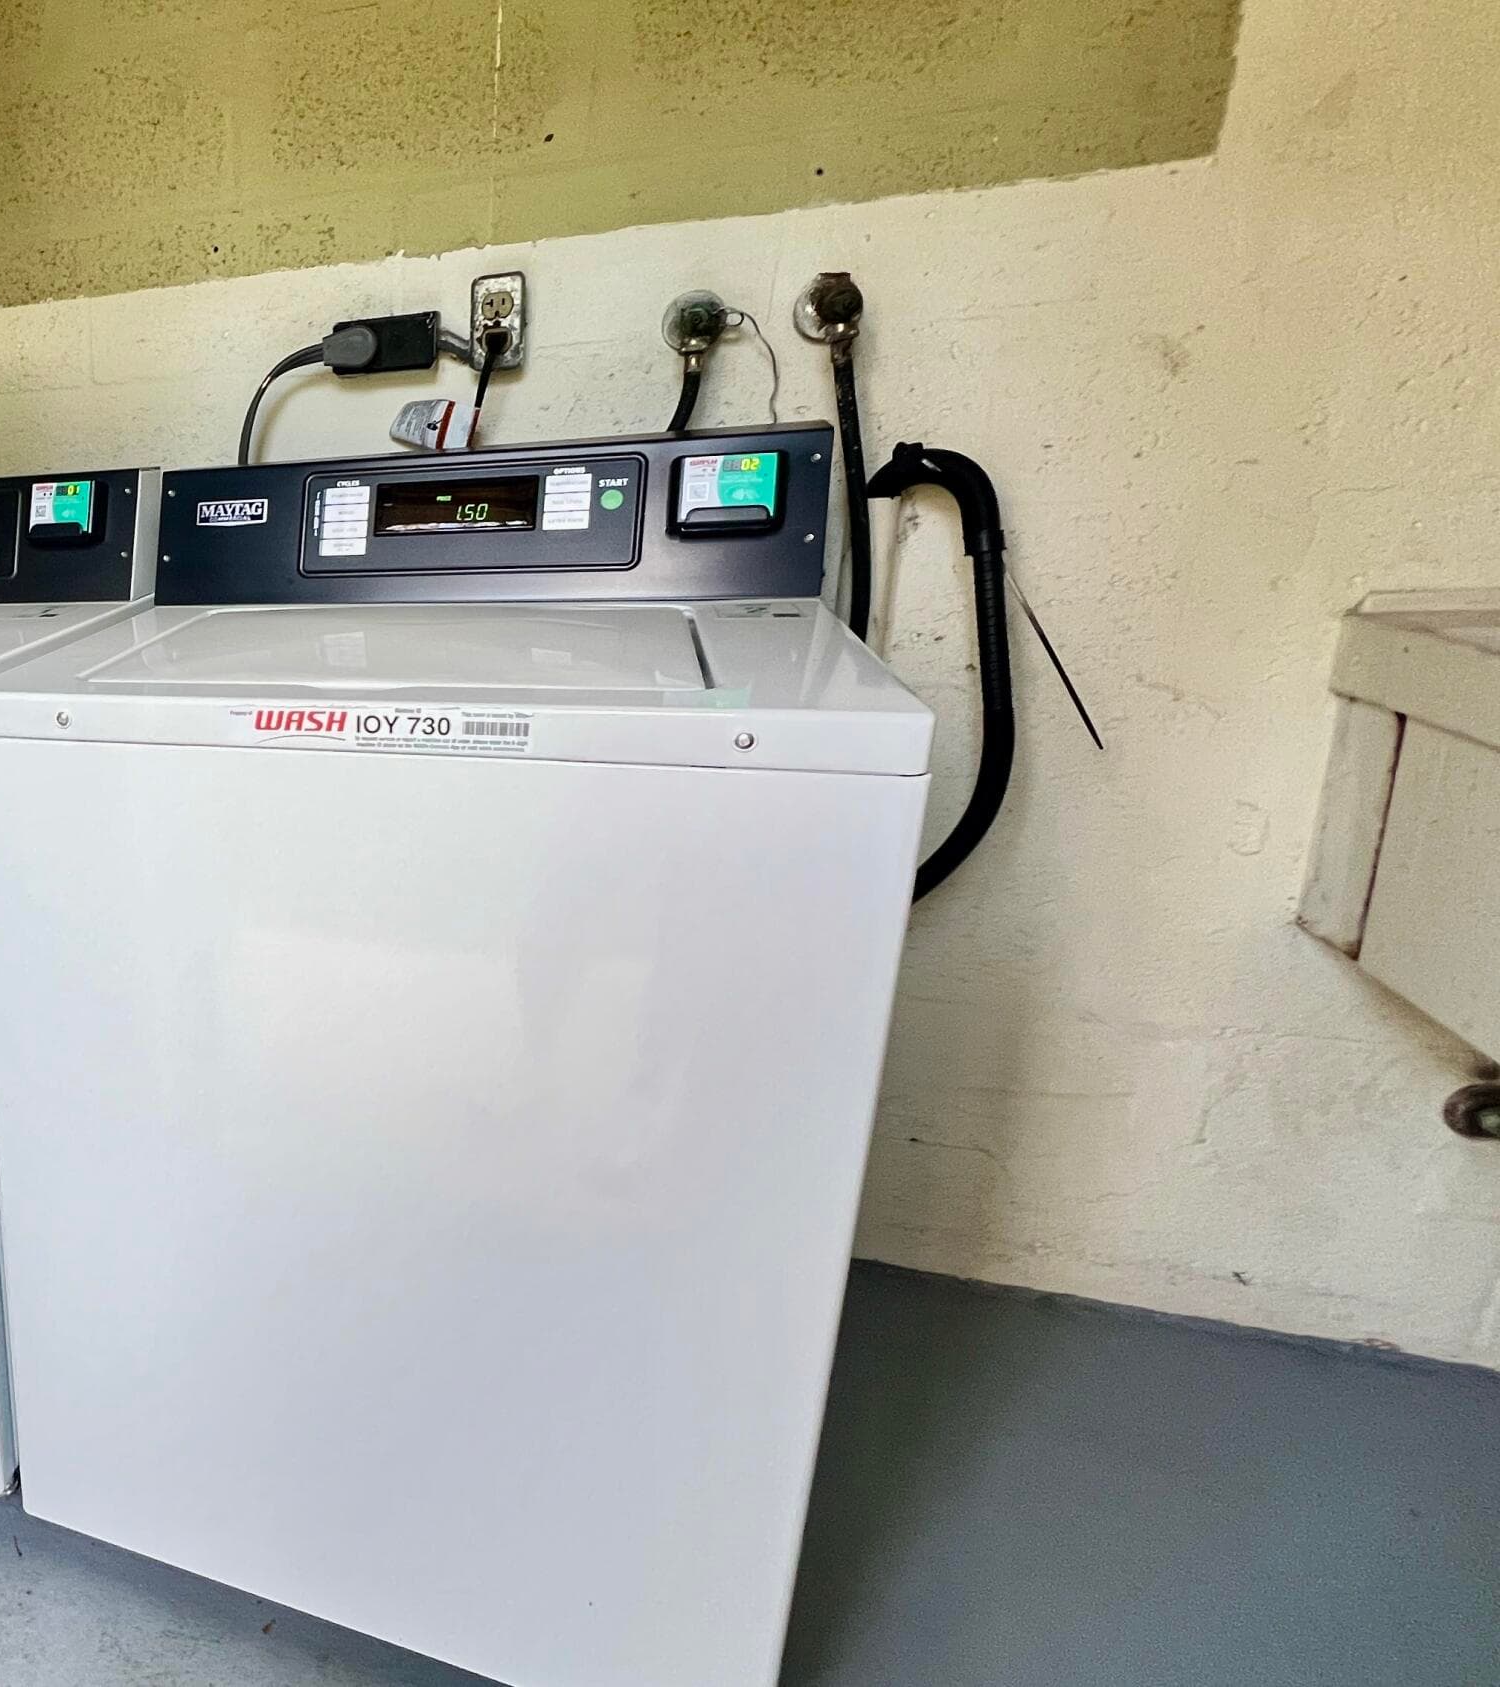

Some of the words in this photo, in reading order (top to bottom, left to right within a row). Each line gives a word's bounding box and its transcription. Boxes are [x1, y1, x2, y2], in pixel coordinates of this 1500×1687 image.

[740, 457, 760, 471] 02
[598, 478, 629, 488] START
[200, 501, 263, 518] MAYTAG
[254, 710, 348, 732] WASH
[355, 715, 399, 735] IOY
[407, 716, 451, 736] 730
